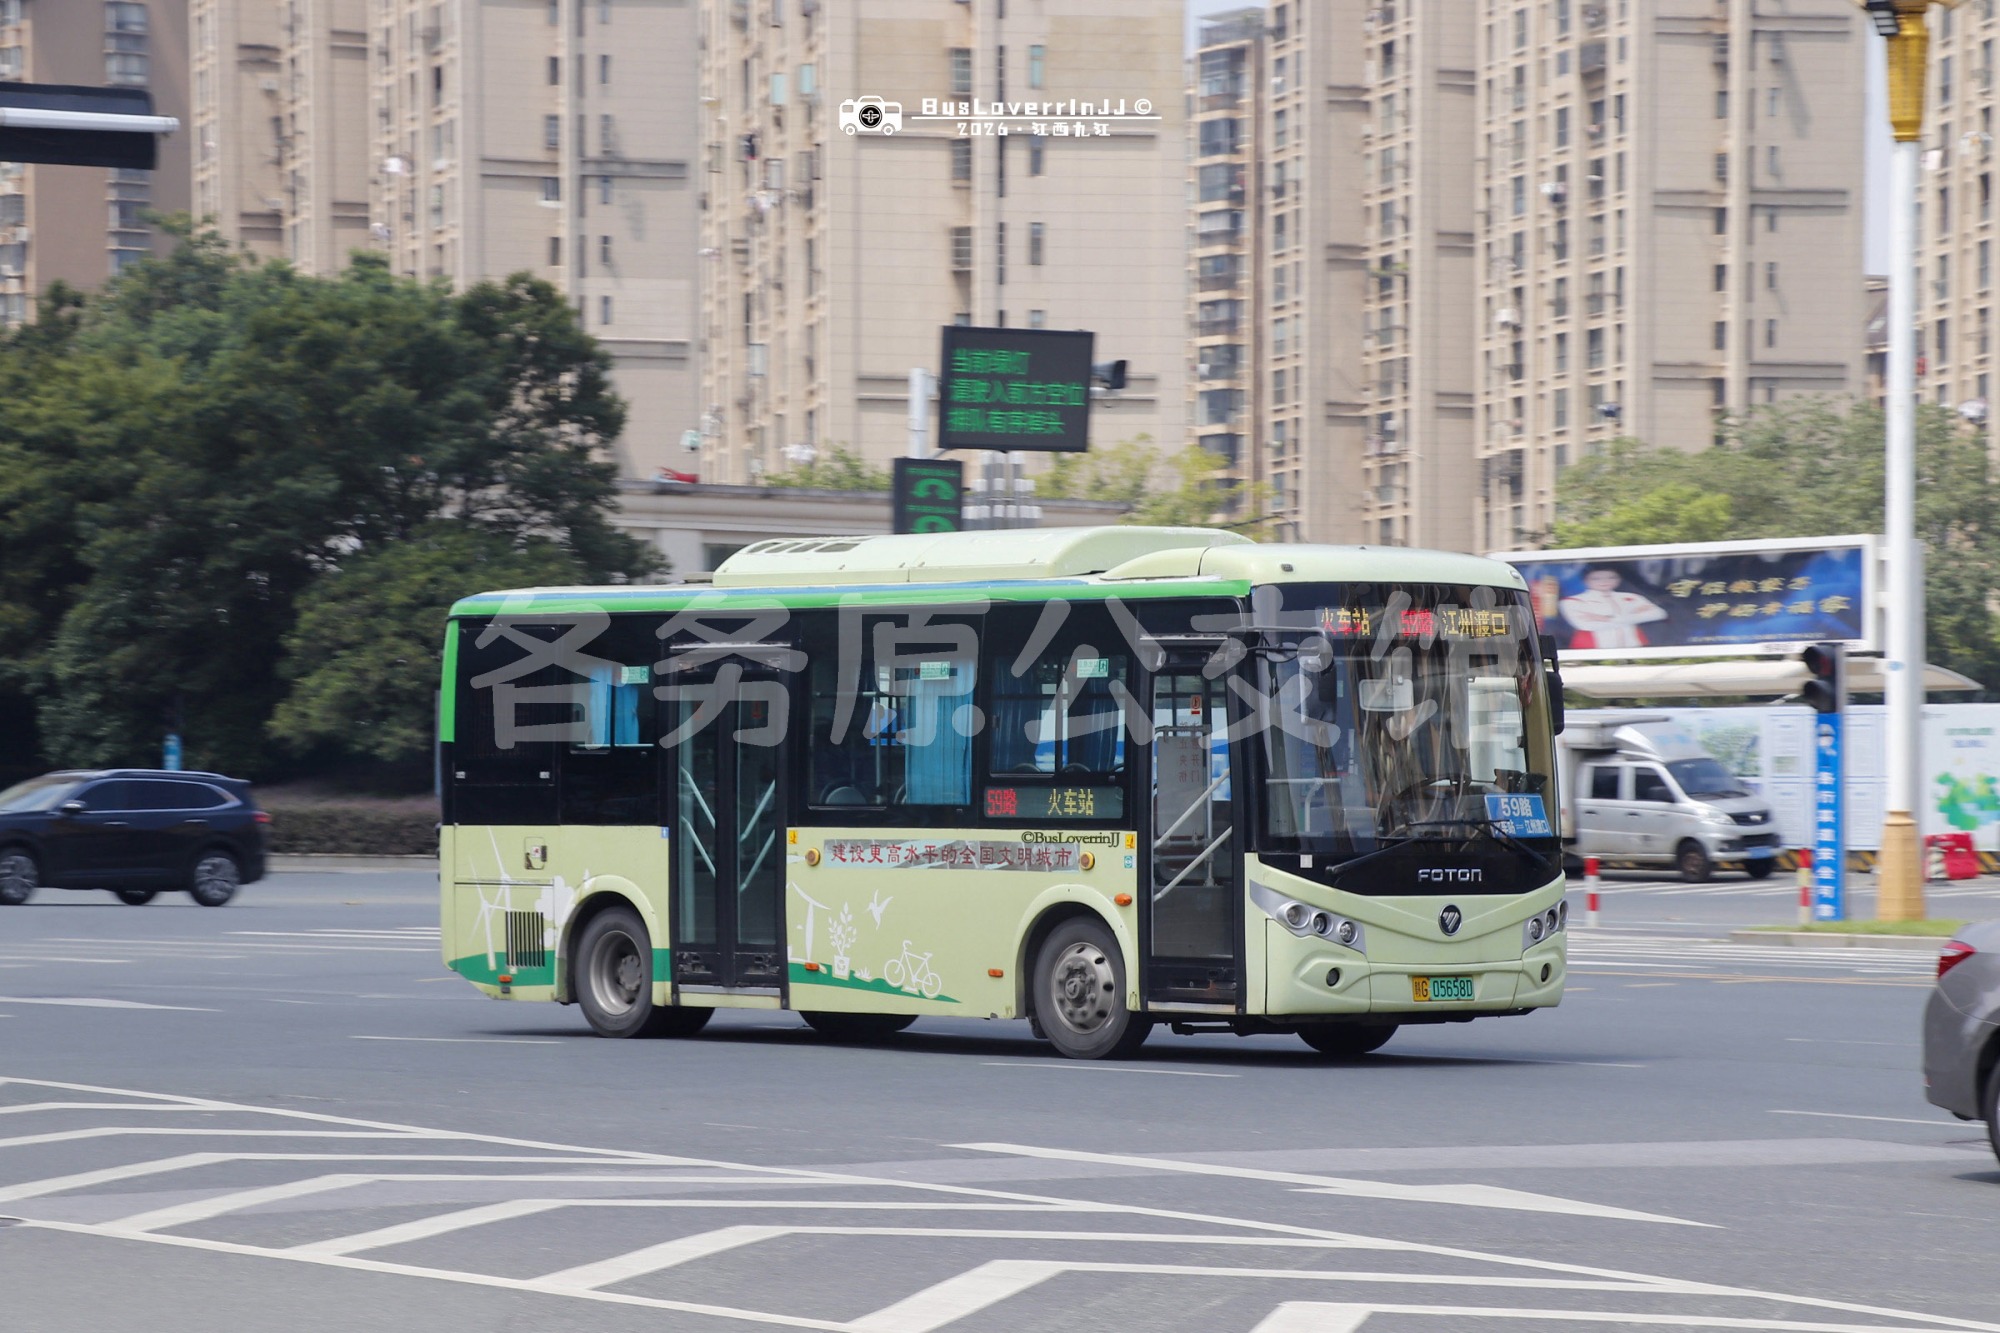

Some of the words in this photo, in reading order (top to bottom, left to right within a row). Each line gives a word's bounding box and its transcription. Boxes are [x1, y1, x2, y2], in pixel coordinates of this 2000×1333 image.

[1321, 607, 1371, 636] 火车站
[1401, 608, 1435, 637] 59路
[1442, 609, 1507, 638] 江州渡口
[986, 788, 1018, 816] 59路
[1047, 788, 1095, 816] 火车站
[1500, 797, 1533, 818] 59路
[831, 843, 1073, 868] 建设更高水平的全国文明城市
[1418, 868, 1482, 882] FOTON
